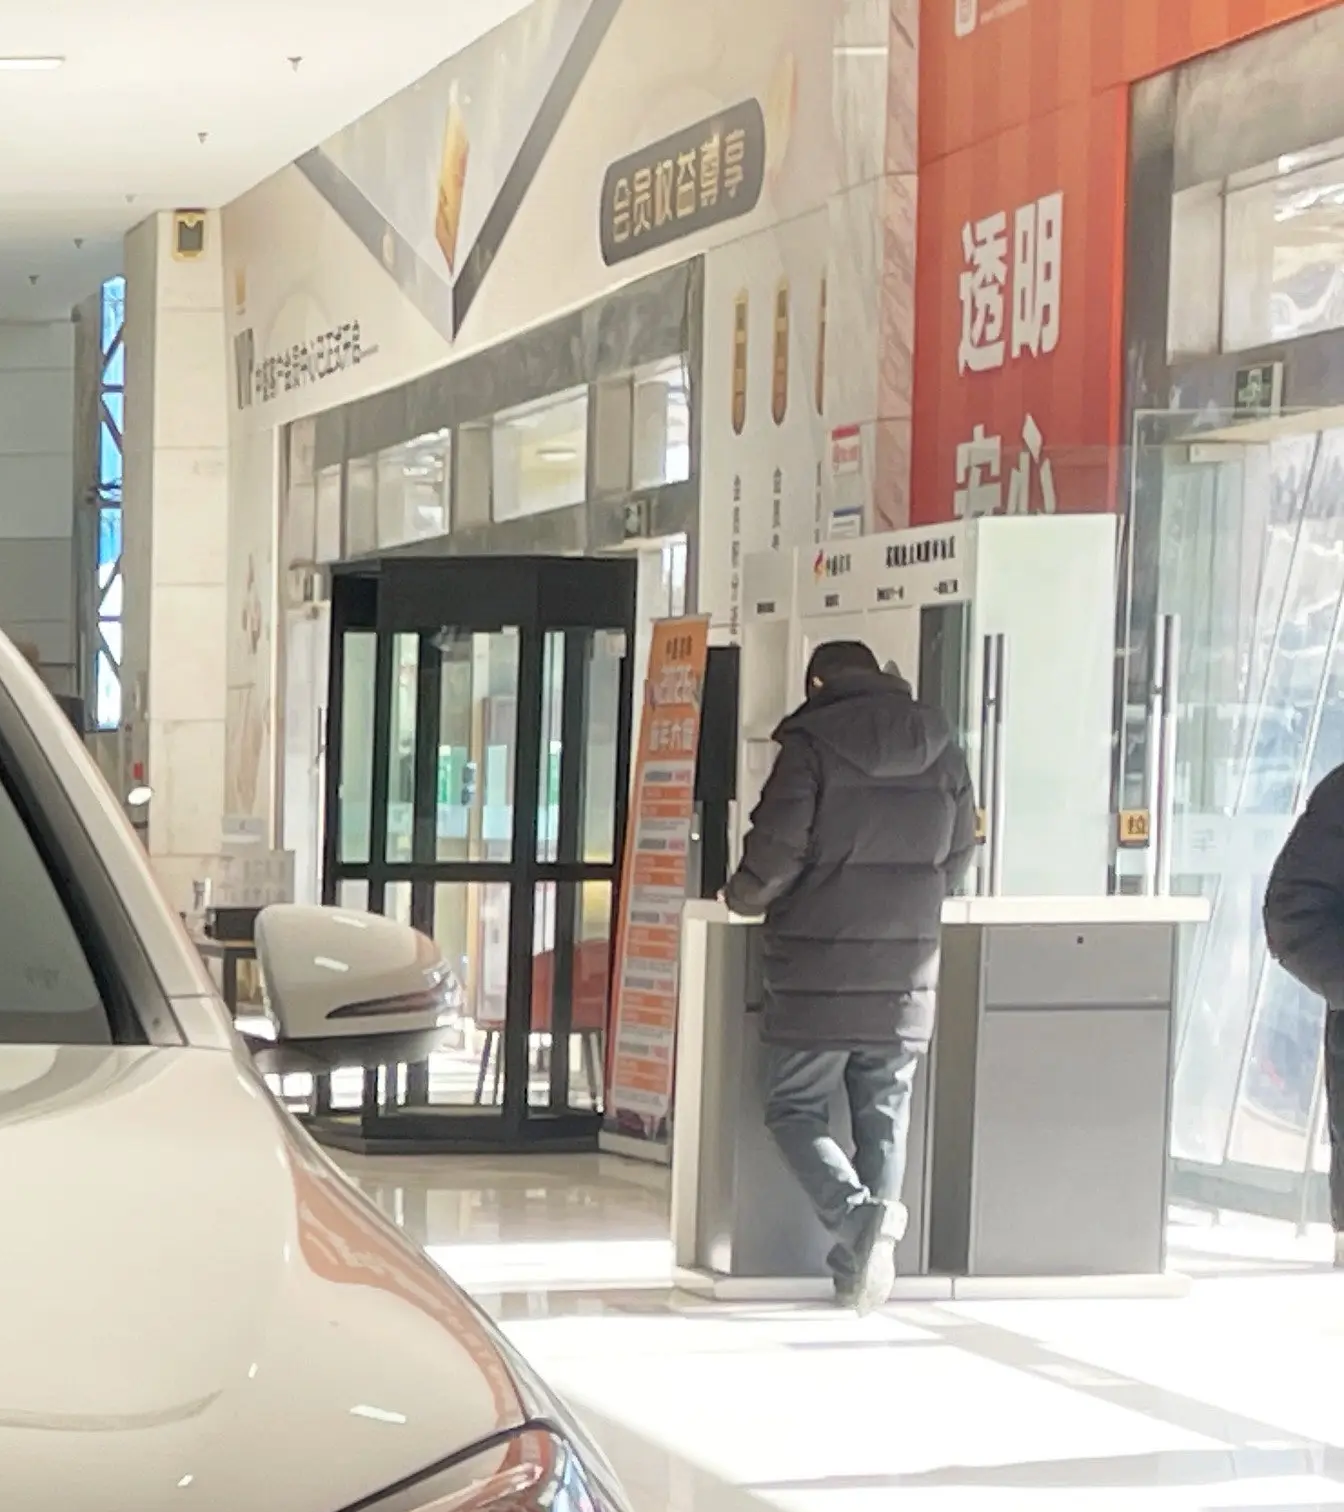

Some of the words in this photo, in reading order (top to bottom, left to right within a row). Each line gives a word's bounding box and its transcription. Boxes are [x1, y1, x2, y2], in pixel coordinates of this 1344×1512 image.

[613, 129, 746, 243] 会员权益尊享
[958, 191, 1064, 376] 透明
[954, 412, 1056, 519] 安心
